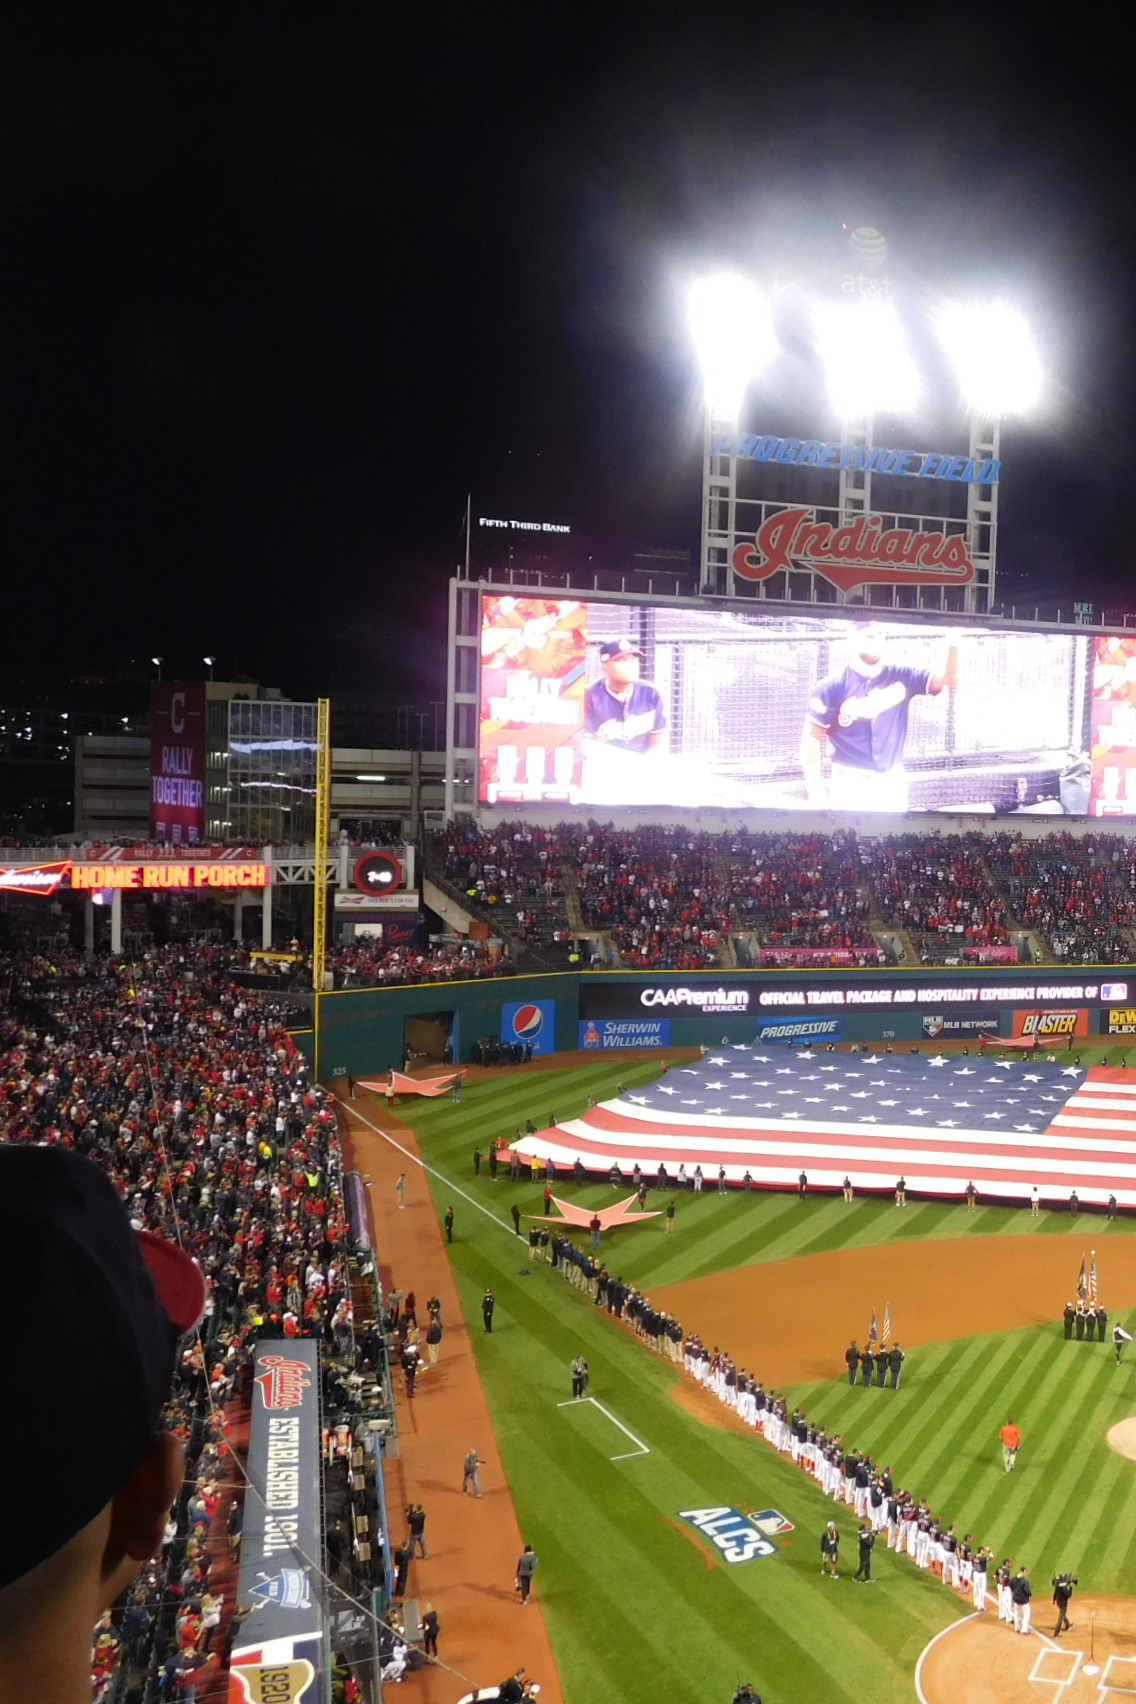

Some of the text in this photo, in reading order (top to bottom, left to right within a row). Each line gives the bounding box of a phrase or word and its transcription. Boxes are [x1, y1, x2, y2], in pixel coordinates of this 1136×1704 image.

[842, 274, 893, 299] at&t
[712, 433, 1001, 484] PROGRESSIVE FIELD
[479, 517, 571, 533] FIFTH THIRD BANK
[732, 508, 975, 590] Indians
[162, 746, 194, 775] RALLY
[152, 776, 203, 809] TOGETHER
[71, 866, 140, 888] HOME
[142, 865, 190, 888] RUN
[193, 865, 267, 888] PORCH
[759, 985, 1098, 1006] OFFICIAL TRAVEL PACKAGE AND HOSPITALITY EXPERIENCE PROVIDER OF
[604, 1022, 660, 1034] SHERWIN
[760, 1020, 839, 1039] PROGRESSIVE
[882, 1030, 894, 1038] 370
[255, 1355, 312, 1410] Indians
[265, 1417, 300, 1510] ESTABLISHED
[679, 1506, 775, 1563] ALCS
[259, 1666, 291, 1704] 1920
